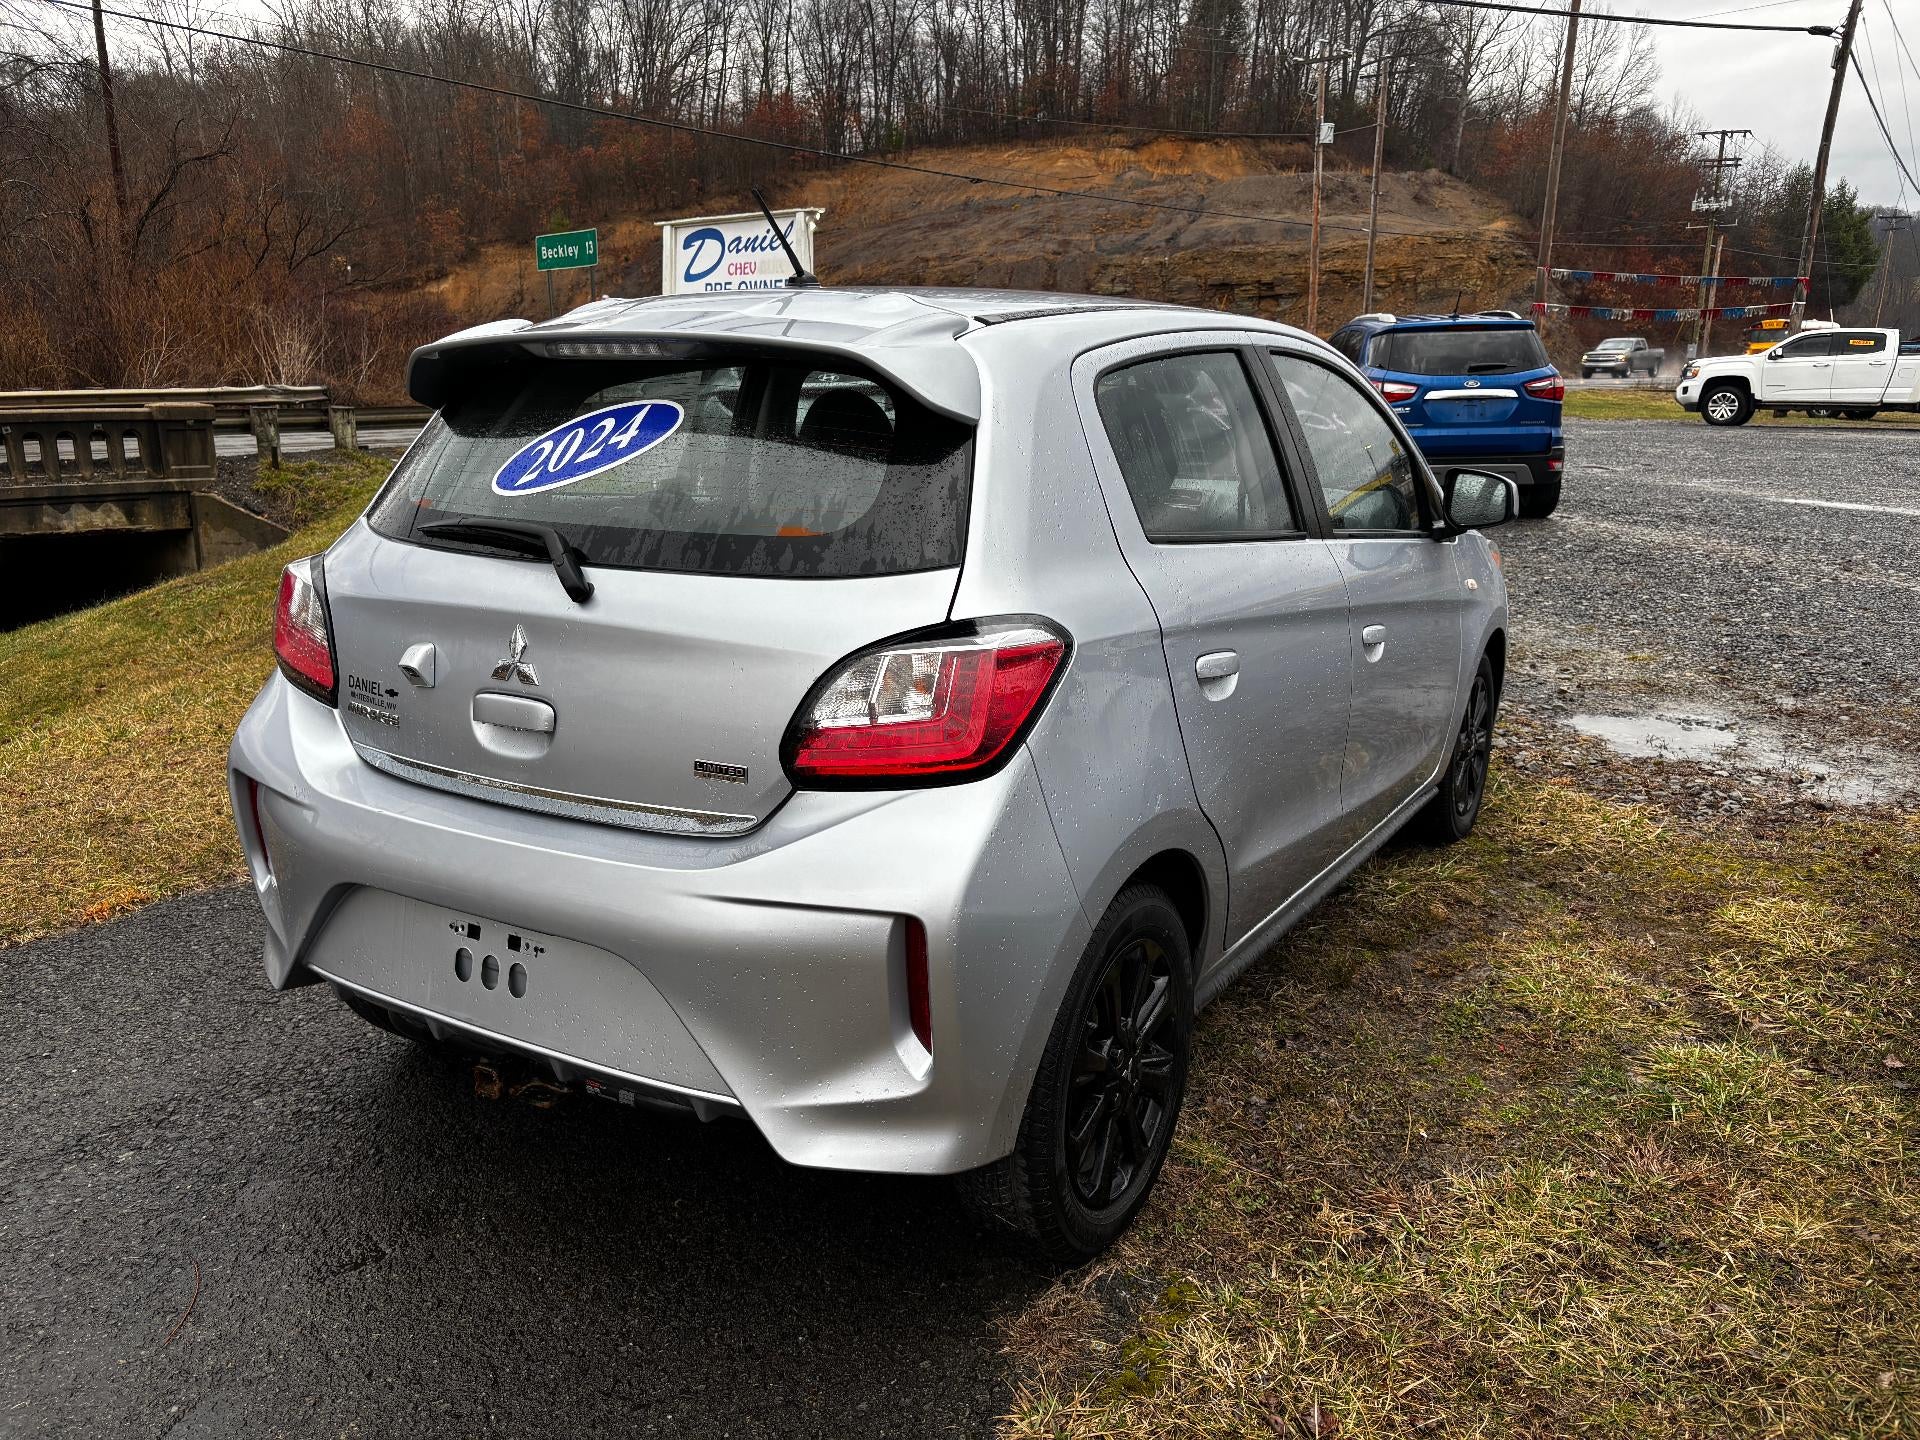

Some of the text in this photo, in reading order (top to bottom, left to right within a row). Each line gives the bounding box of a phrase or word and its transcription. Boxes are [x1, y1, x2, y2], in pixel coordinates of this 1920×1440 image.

[541, 240, 594, 260] Beckley 13
[682, 220, 795, 283] Daniel
[727, 261, 758, 276] CHEV
[514, 404, 652, 487] 2024
[348, 674, 384, 698] DANIEL
[696, 762, 744, 776] LIMITED
